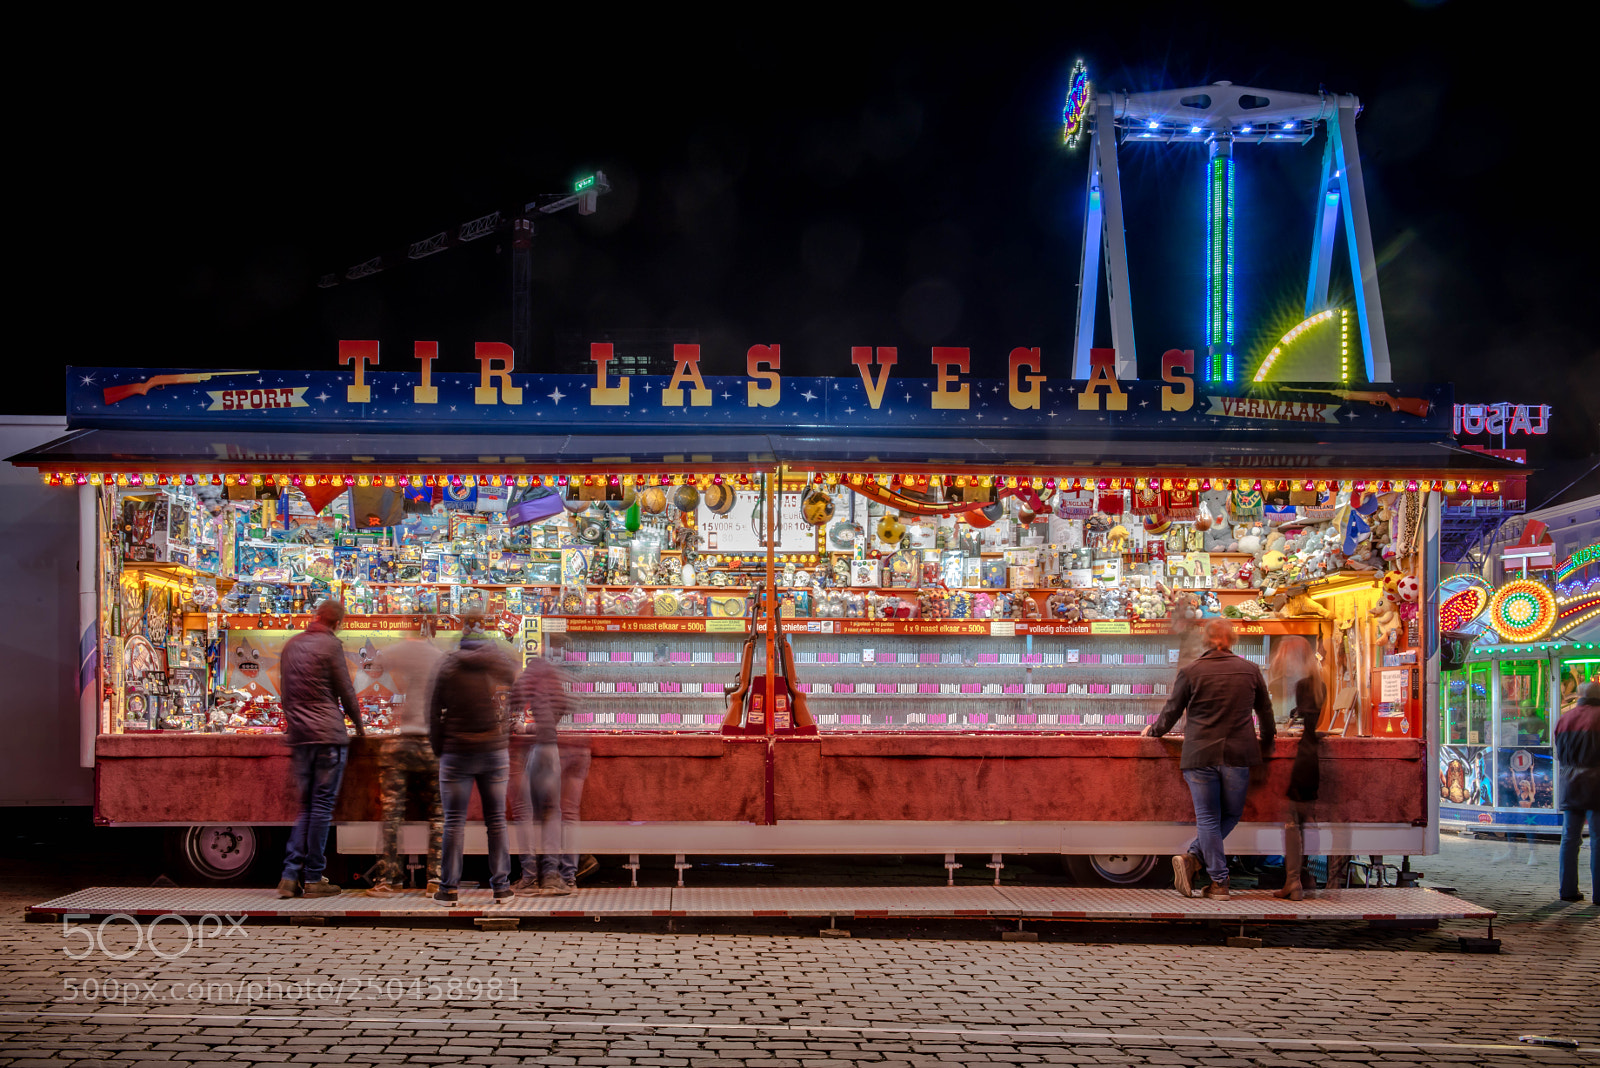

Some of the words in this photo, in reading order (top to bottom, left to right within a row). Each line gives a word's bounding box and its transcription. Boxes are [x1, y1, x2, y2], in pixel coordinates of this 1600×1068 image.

[338, 339, 523, 405] TIR
[589, 342, 781, 408] LAS
[850, 346, 1196, 412] VEGAS
[222, 387, 294, 411] SPORT
[1220, 396, 1327, 423] VERMAAK
[702, 522, 714, 531] 15
[714, 522, 733, 531] VOOR
[299, 620, 305, 629] 4
[350, 620, 371, 629] elkaar
[379, 620, 388, 629] 10
[389, 620, 412, 630] punten
[621, 622, 627, 630] 4
[633, 622, 638, 630] 9
[639, 622, 657, 630] naast
[658, 622, 679, 630] elkaar
[903, 625, 909, 633] 4
[915, 625, 920, 633] 9
[921, 625, 938, 633] naast
[939, 625, 960, 633] elkaar
[1029, 625, 1053, 635] volledig
[1055, 625, 1088, 633] afschieten
[1517, 755, 1524, 767] 1
